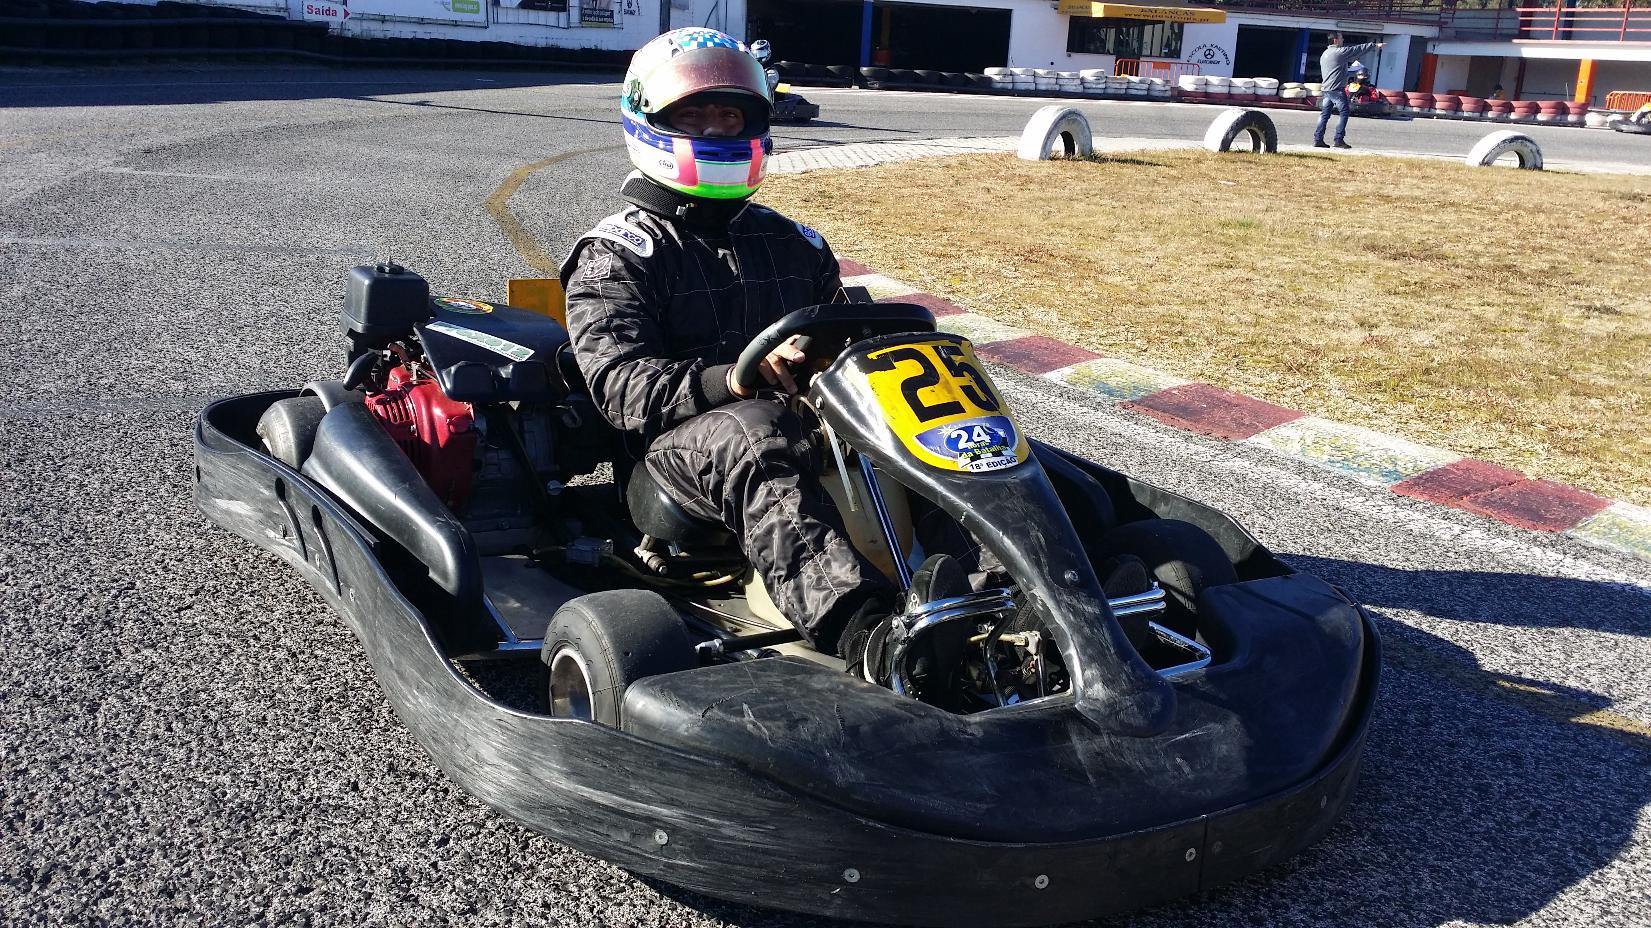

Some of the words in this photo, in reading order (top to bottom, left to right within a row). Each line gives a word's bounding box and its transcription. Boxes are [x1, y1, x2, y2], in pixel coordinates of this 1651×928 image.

[306, 4, 337, 17] Saída
[865, 345, 1000, 423] 25
[950, 425, 991, 450] 24
[961, 451, 974, 459] da
[974, 444, 1006, 456] Batalha
[986, 456, 1017, 469] EDIÇÃO
